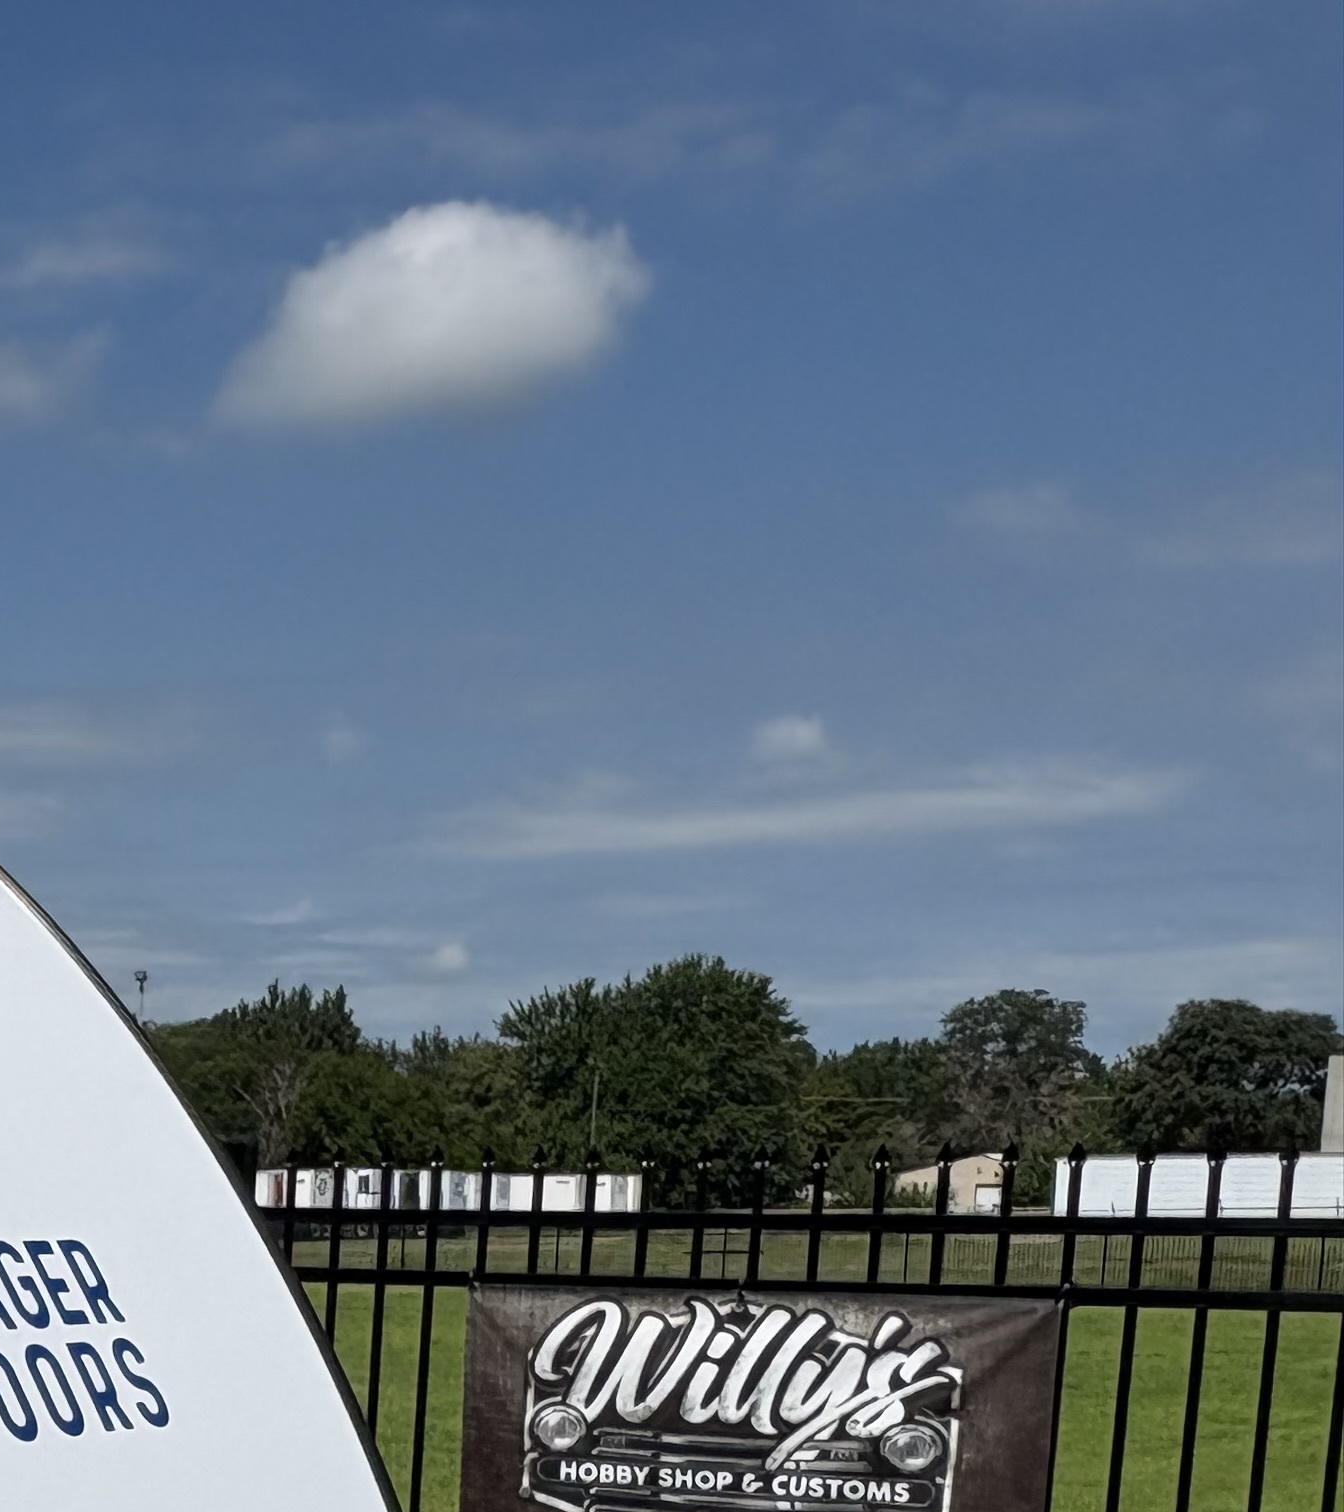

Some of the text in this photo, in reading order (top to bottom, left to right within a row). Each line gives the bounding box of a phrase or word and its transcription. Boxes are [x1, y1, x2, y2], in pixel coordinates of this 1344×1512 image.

[532, 1301, 954, 1471] Willy's
[559, 1460, 910, 1503] HOBBY SHOP & CUSTOMS
